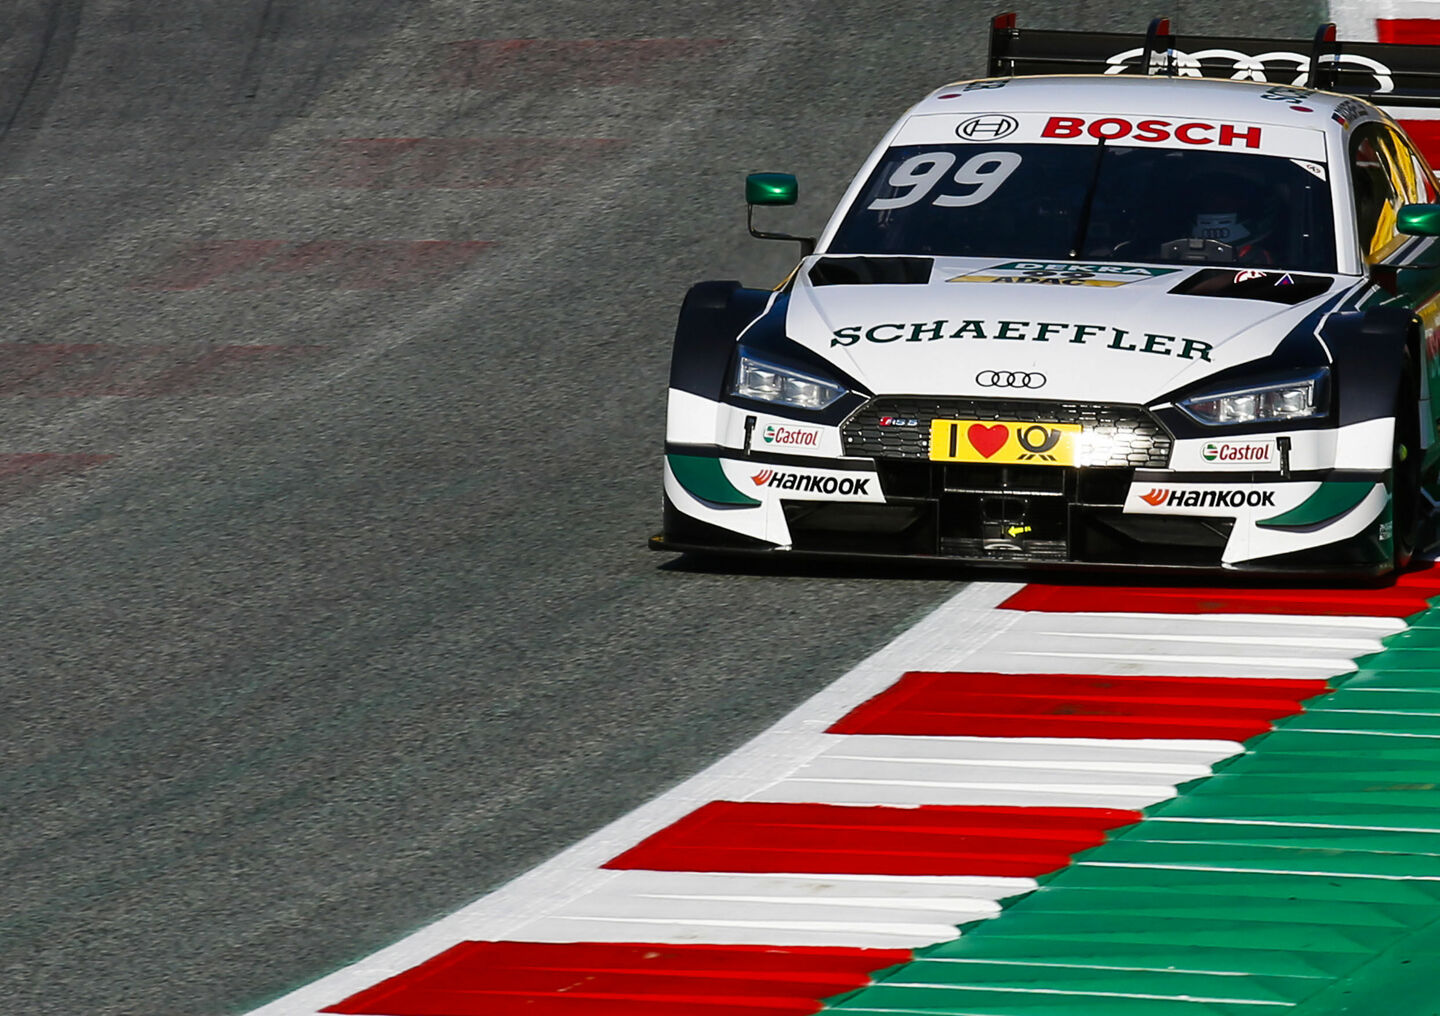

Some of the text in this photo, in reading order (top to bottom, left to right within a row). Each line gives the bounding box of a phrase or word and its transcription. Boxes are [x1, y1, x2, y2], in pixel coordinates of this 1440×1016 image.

[1039, 116, 1262, 150] BOSCH
[867, 151, 1023, 210] 99
[1014, 262, 1153, 275] DEKRA
[991, 276, 1086, 286] ADAC
[830, 319, 1215, 363] SCHAEFFLER
[775, 427, 819, 446] Castrol
[1219, 443, 1270, 461] Castrol
